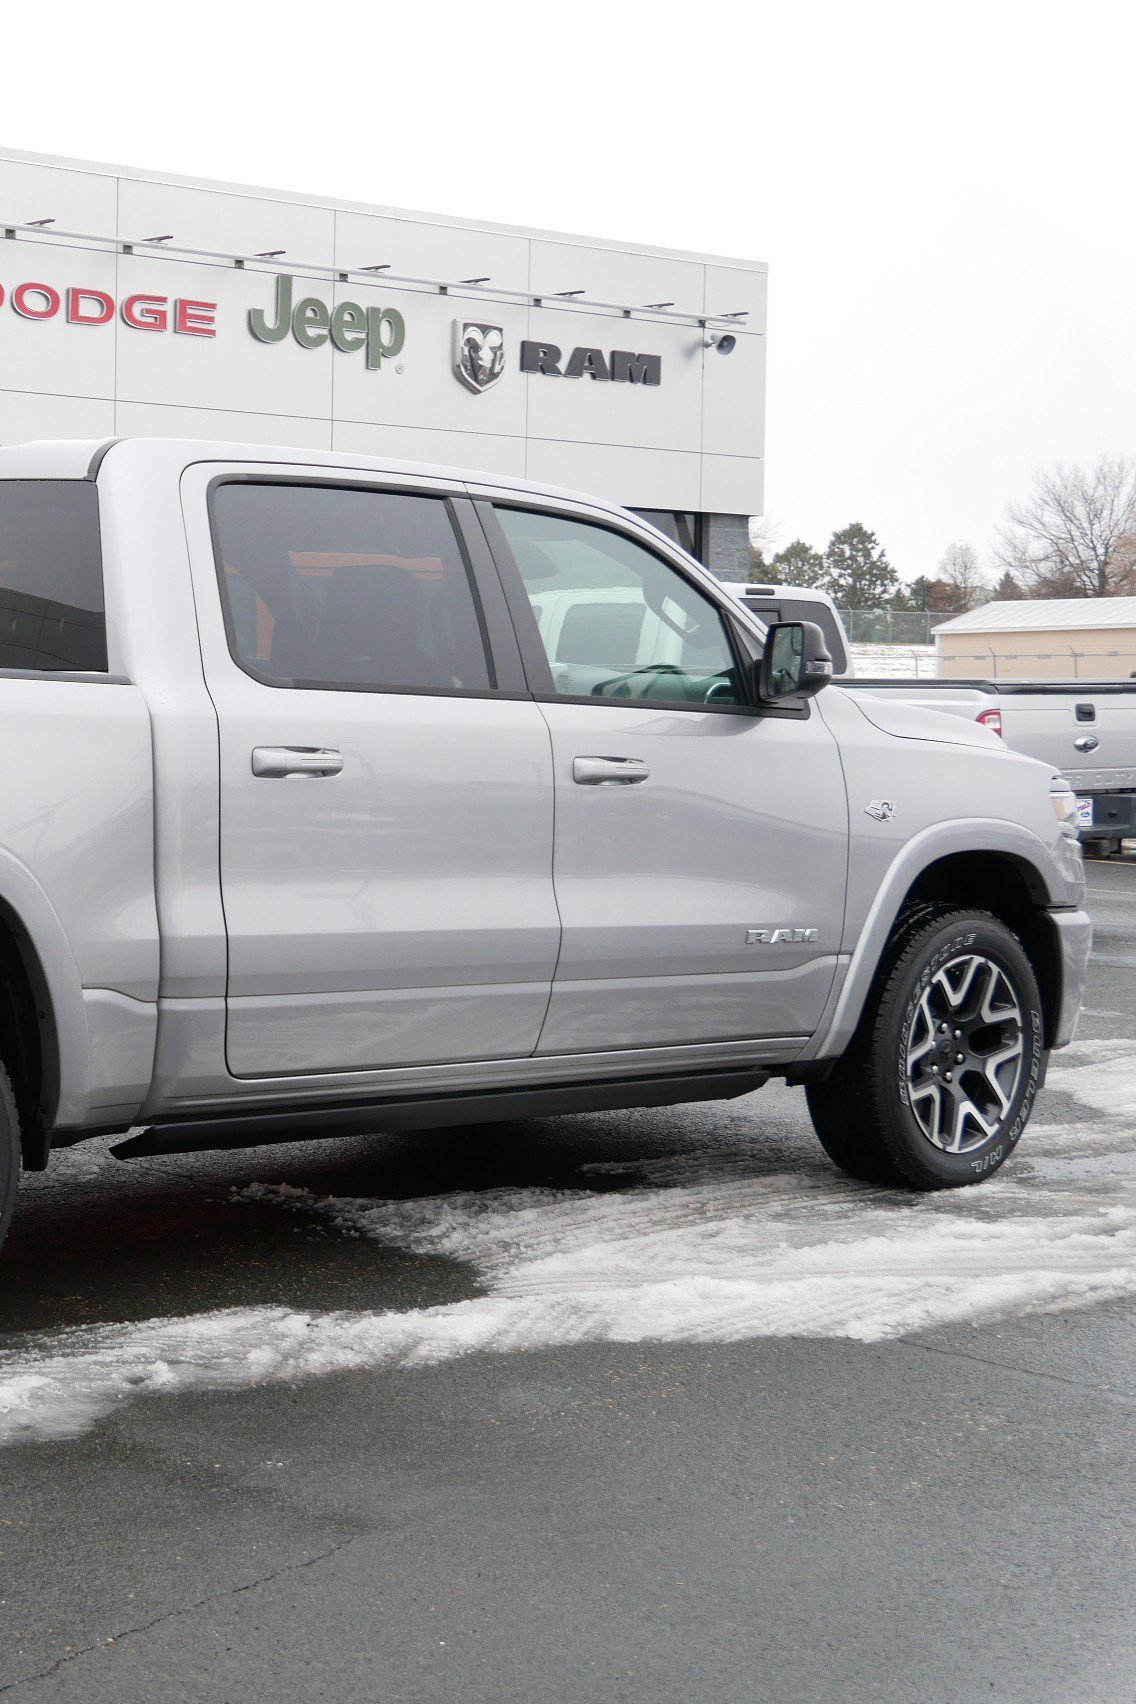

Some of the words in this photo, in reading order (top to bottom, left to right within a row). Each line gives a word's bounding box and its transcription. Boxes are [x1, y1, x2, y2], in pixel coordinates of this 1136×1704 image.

[247, 274, 406, 370] Jeep
[520, 340, 662, 386] RAM
[745, 928, 818, 944] RAM
